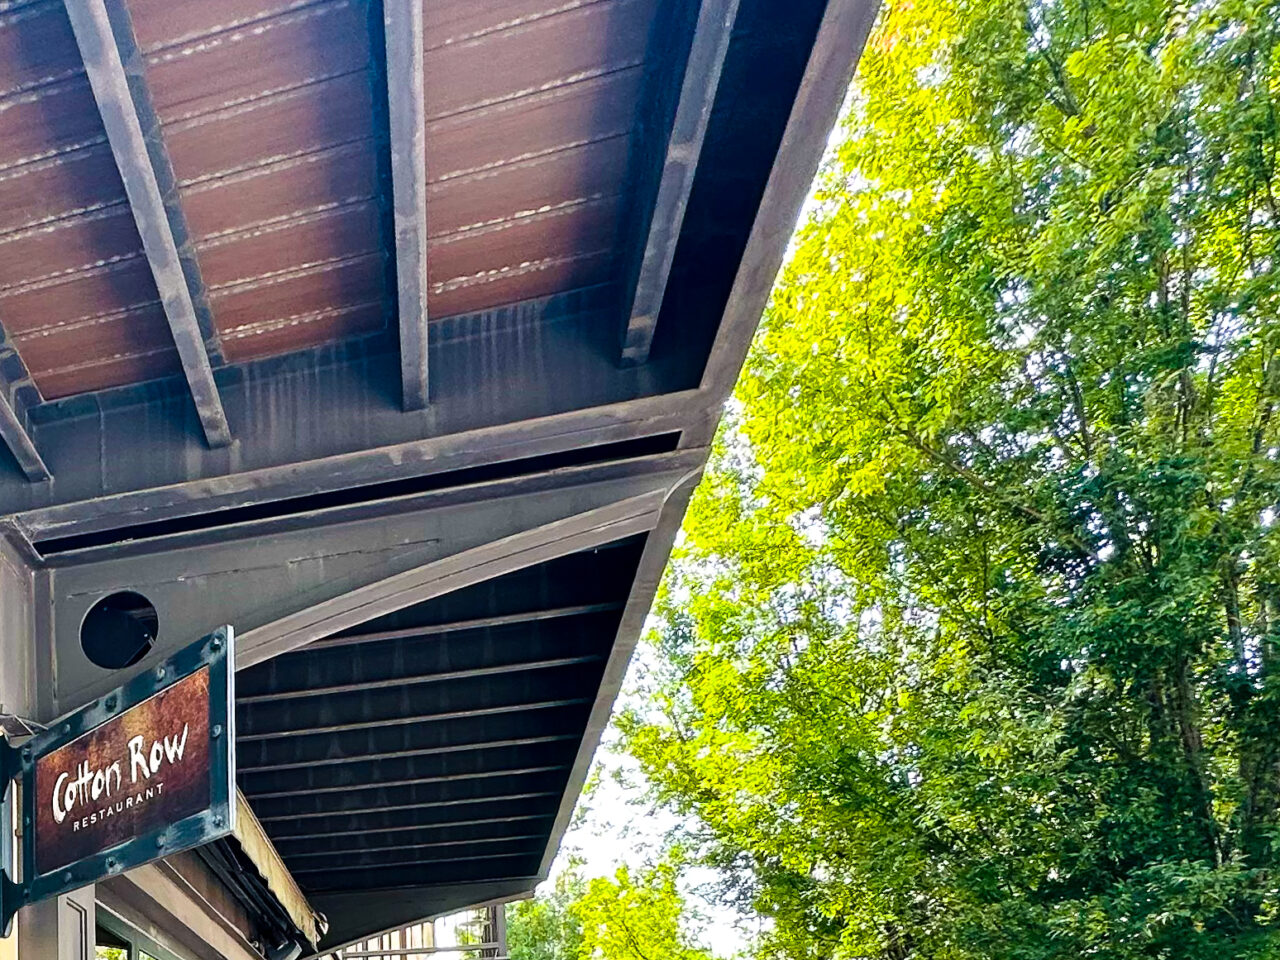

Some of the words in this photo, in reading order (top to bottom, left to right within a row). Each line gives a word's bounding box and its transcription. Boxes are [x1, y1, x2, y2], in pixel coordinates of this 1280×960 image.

[52, 760, 122, 824] Cotton
[127, 722, 189, 784] Row
[73, 783, 165, 832] RESTAURANT
